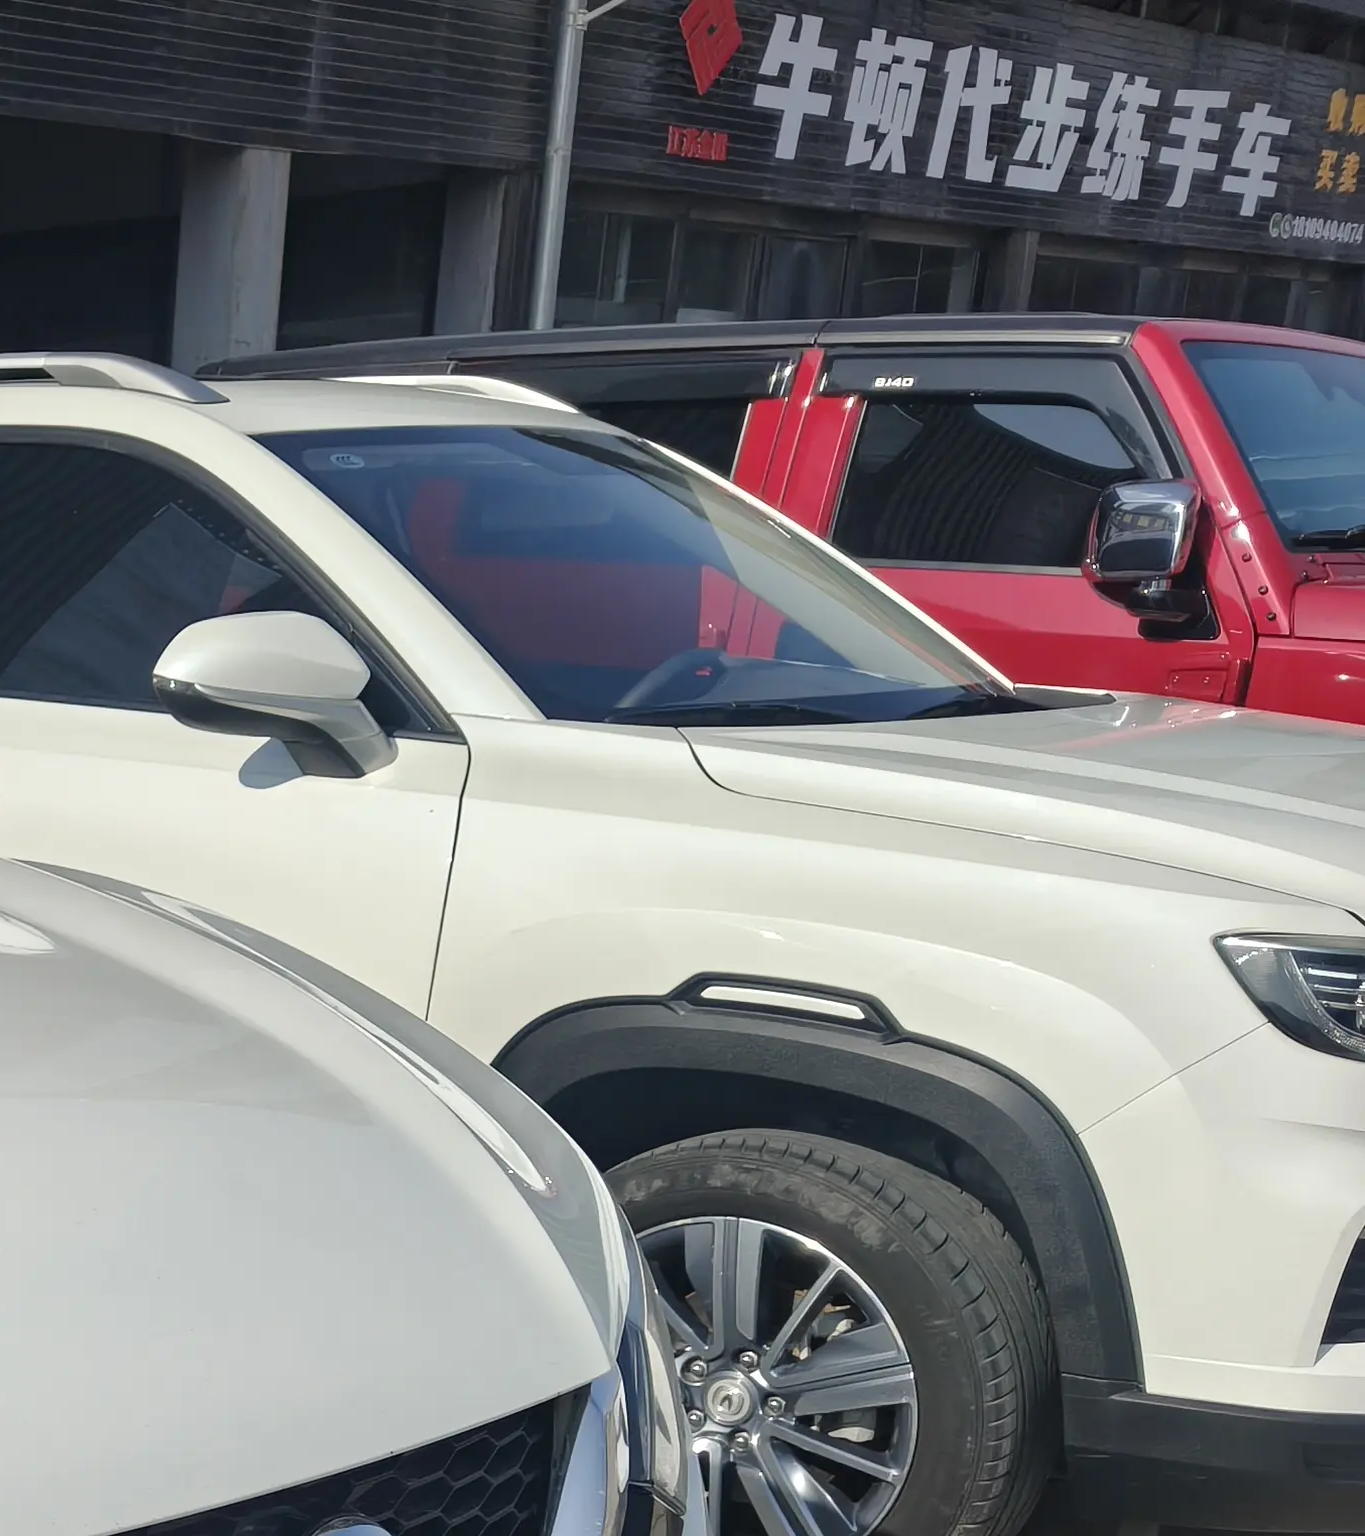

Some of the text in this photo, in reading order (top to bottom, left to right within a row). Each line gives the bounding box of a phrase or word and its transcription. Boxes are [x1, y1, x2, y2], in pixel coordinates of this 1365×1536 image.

[753, 13, 1292, 217] 牛顿代步练手车
